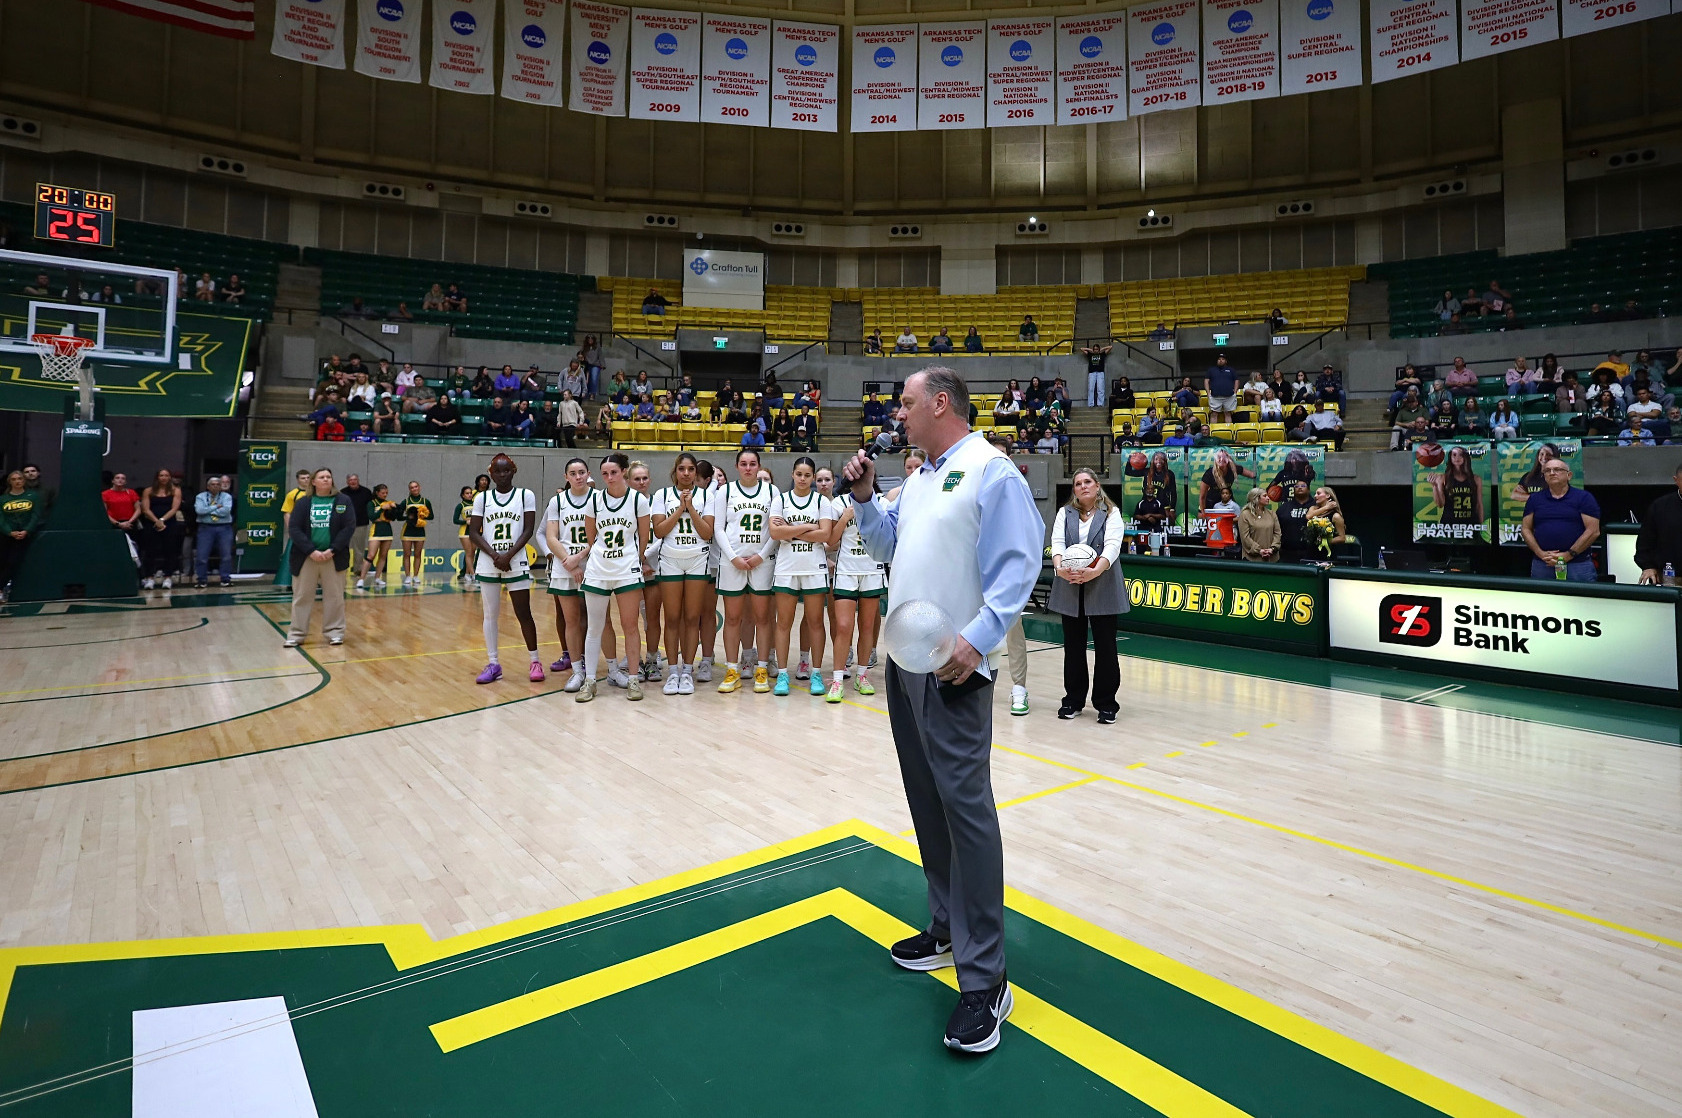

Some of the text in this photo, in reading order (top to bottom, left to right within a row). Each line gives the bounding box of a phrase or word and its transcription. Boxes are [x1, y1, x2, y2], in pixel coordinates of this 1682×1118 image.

[572, 2, 610, 13] ARKANSAS
[613, 8, 628, 16] TECH
[1131, 2, 1195, 18] ARKANSAS TECH
[1390, 3, 1428, 17] DIVISION
[1594, 2, 1636, 20] 2016
[581, 13, 620, 23] UNIVERSITY
[635, 15, 677, 23] ARKANSAS
[1140, 10, 1186, 23] MEN'S GOLF
[1393, 9, 1432, 23] CENTRAL
[589, 23, 611, 31] MEN'S
[707, 20, 746, 28] ARKANSAS
[1377, 10, 1449, 34] SUPER REGIONAL
[591, 31, 608, 39] GOLF
[776, 27, 816, 35] ARKANSAS
[1391, 26, 1429, 40] DIVISION
[377, 36, 400, 45] SOUTH
[1299, 35, 1335, 45] DIVISION
[1392, 32, 1435, 47] NATIONAL
[1490, 28, 1528, 46] 2015
[374, 43, 401, 53] REGION
[1302, 41, 1339, 51] CENTRAL
[1379, 35, 1449, 56] CHAMPIONSHIPS
[364, 47, 411, 62] TOURNAMENT
[451, 50, 473, 59] SOUTH
[1145, 48, 1176, 58] DIVISION
[1287, 45, 1355, 60] SUPER REGIONAL
[449, 57, 475, 67] REGION
[1135, 58, 1194, 72] SUPER REGIONAL
[1397, 52, 1431, 68] 2014
[439, 63, 484, 74] TOURNAMENT
[523, 63, 544, 71] SOUTH
[521, 70, 545, 79] REGION
[632, 71, 698, 80] SOUTH/SOUTHEAST
[801, 69, 834, 77] AMERICAN
[1145, 70, 1176, 80] DIVISION
[1306, 71, 1337, 84] 2013
[511, 75, 554, 87] TOURNAMENT
[703, 75, 768, 85] SOUTH/SOUTHEAST
[784, 75, 827, 83] CONFERENCE
[1146, 75, 1182, 86] NATIONAL
[641, 84, 689, 92] TOURNAMENT
[719, 83, 753, 91] REGIONAL
[1217, 82, 1265, 96] 2018-19
[712, 89, 758, 97] TOURNAMENT
[773, 95, 836, 105] CENTRAL/MIDWEST
[1143, 92, 1186, 106] 2017-18
[649, 103, 680, 113] 2009
[721, 107, 749, 117] 2010
[1070, 105, 1113, 117] 2016-17
[792, 113, 818, 123] 2013
[938, 114, 965, 123] 2015
[1007, 109, 1034, 118] 2016
[871, 115, 897, 124] 2014
[49, 208, 100, 244] 25
[711, 263, 758, 273] Crafton Tull
[65, 427, 101, 436] SPALDING
[250, 453, 276, 461] TECH
[248, 491, 274, 499] TECH
[1453, 496, 1472, 509] 24
[733, 502, 769, 514] ARKANSAS
[485, 511, 521, 523] ARKANSAS
[562, 514, 586, 526] ARKAN
[598, 517, 632, 529] ARKANSAS
[678, 518, 693, 534] 11
[739, 513, 762, 532] 42
[1208, 519, 1217, 531] G
[247, 529, 273, 537] TECH
[494, 523, 512, 540] 21
[570, 526, 588, 543] 12
[1417, 529, 1474, 539] PRATER
[604, 529, 624, 549] 24
[674, 536, 697, 545] TECH
[739, 534, 761, 544] TECH
[492, 542, 514, 551] TECH
[791, 543, 813, 553] TECH
[602, 549, 623, 558] TECH
[1122, 578, 1315, 626] ONDER BOYS
[1454, 605, 1602, 638] Simmons
[1454, 627, 1530, 655] Bank
